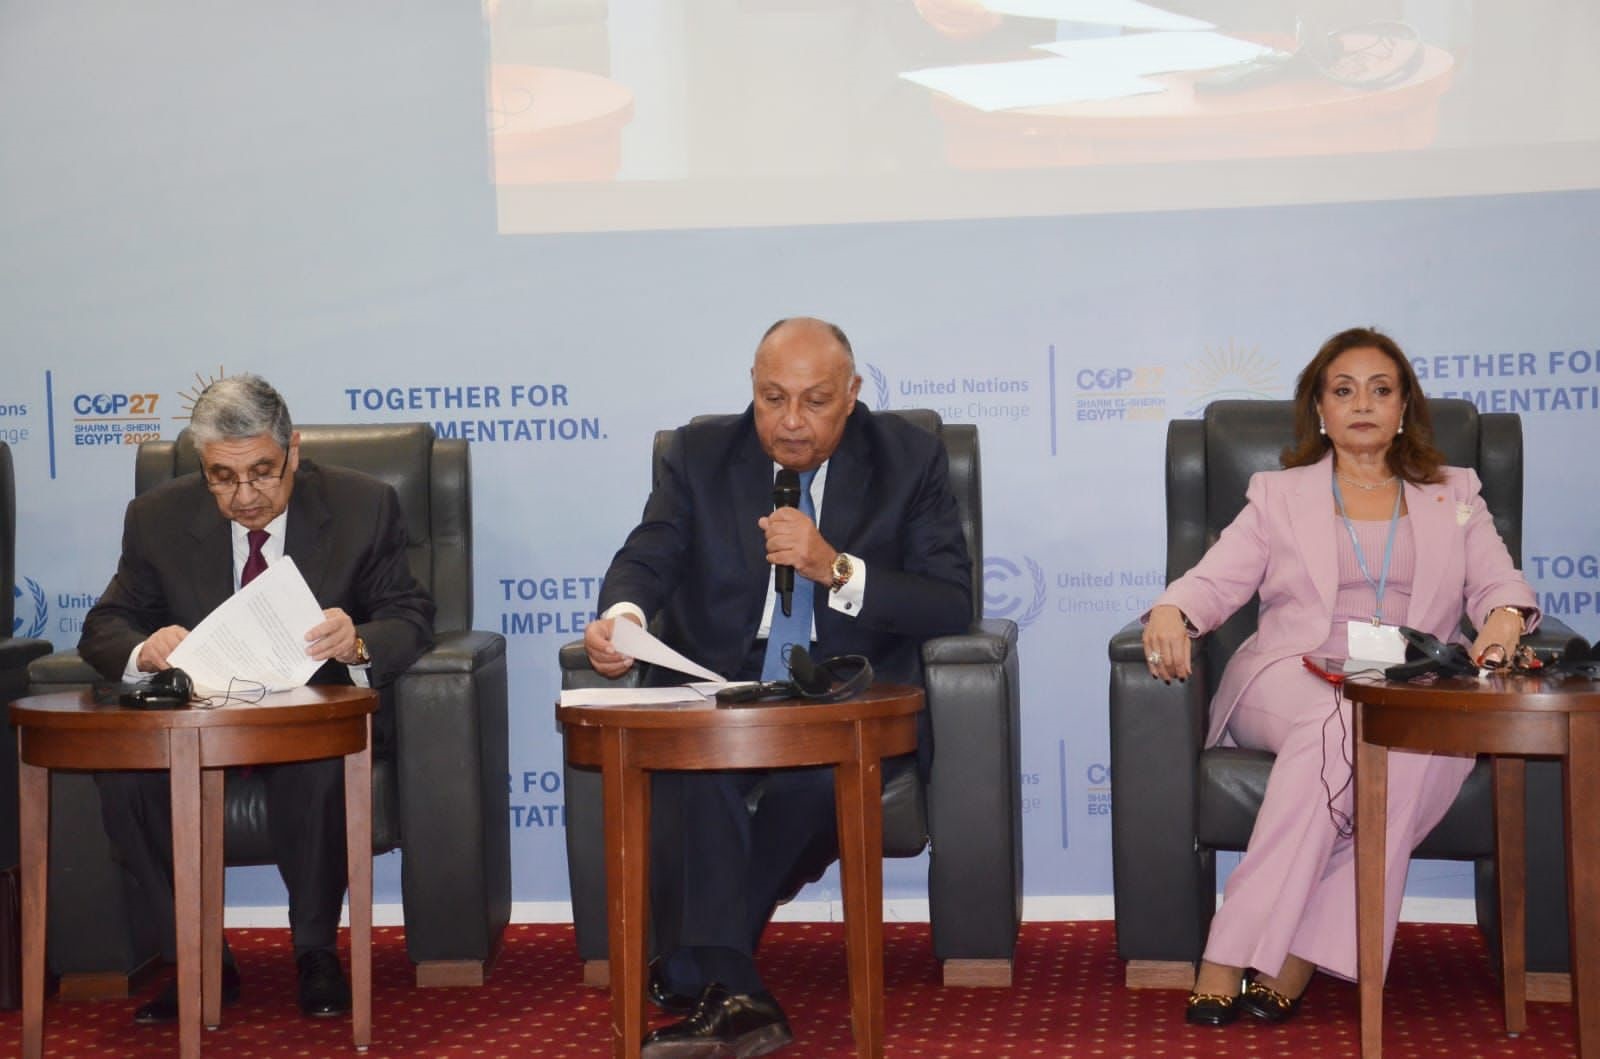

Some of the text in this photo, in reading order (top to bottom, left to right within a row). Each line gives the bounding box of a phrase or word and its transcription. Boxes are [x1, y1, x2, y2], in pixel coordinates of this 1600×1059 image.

[1549, 350, 1600, 375] FO
[899, 377, 1030, 396] United Nations
[73, 393, 160, 415] COP27
[345, 384, 568, 411] TOGETHER FOR
[967, 401, 1031, 421] Change
[1077, 408, 1127, 422] EGYPT
[74, 423, 160, 433] SHARM EL-SHEIKH
[74, 432, 160, 446] EGYPT 2022
[1056, 571, 1113, 588] United
[1057, 598, 1121, 614] Climate
[59, 617, 83, 633] Cli
